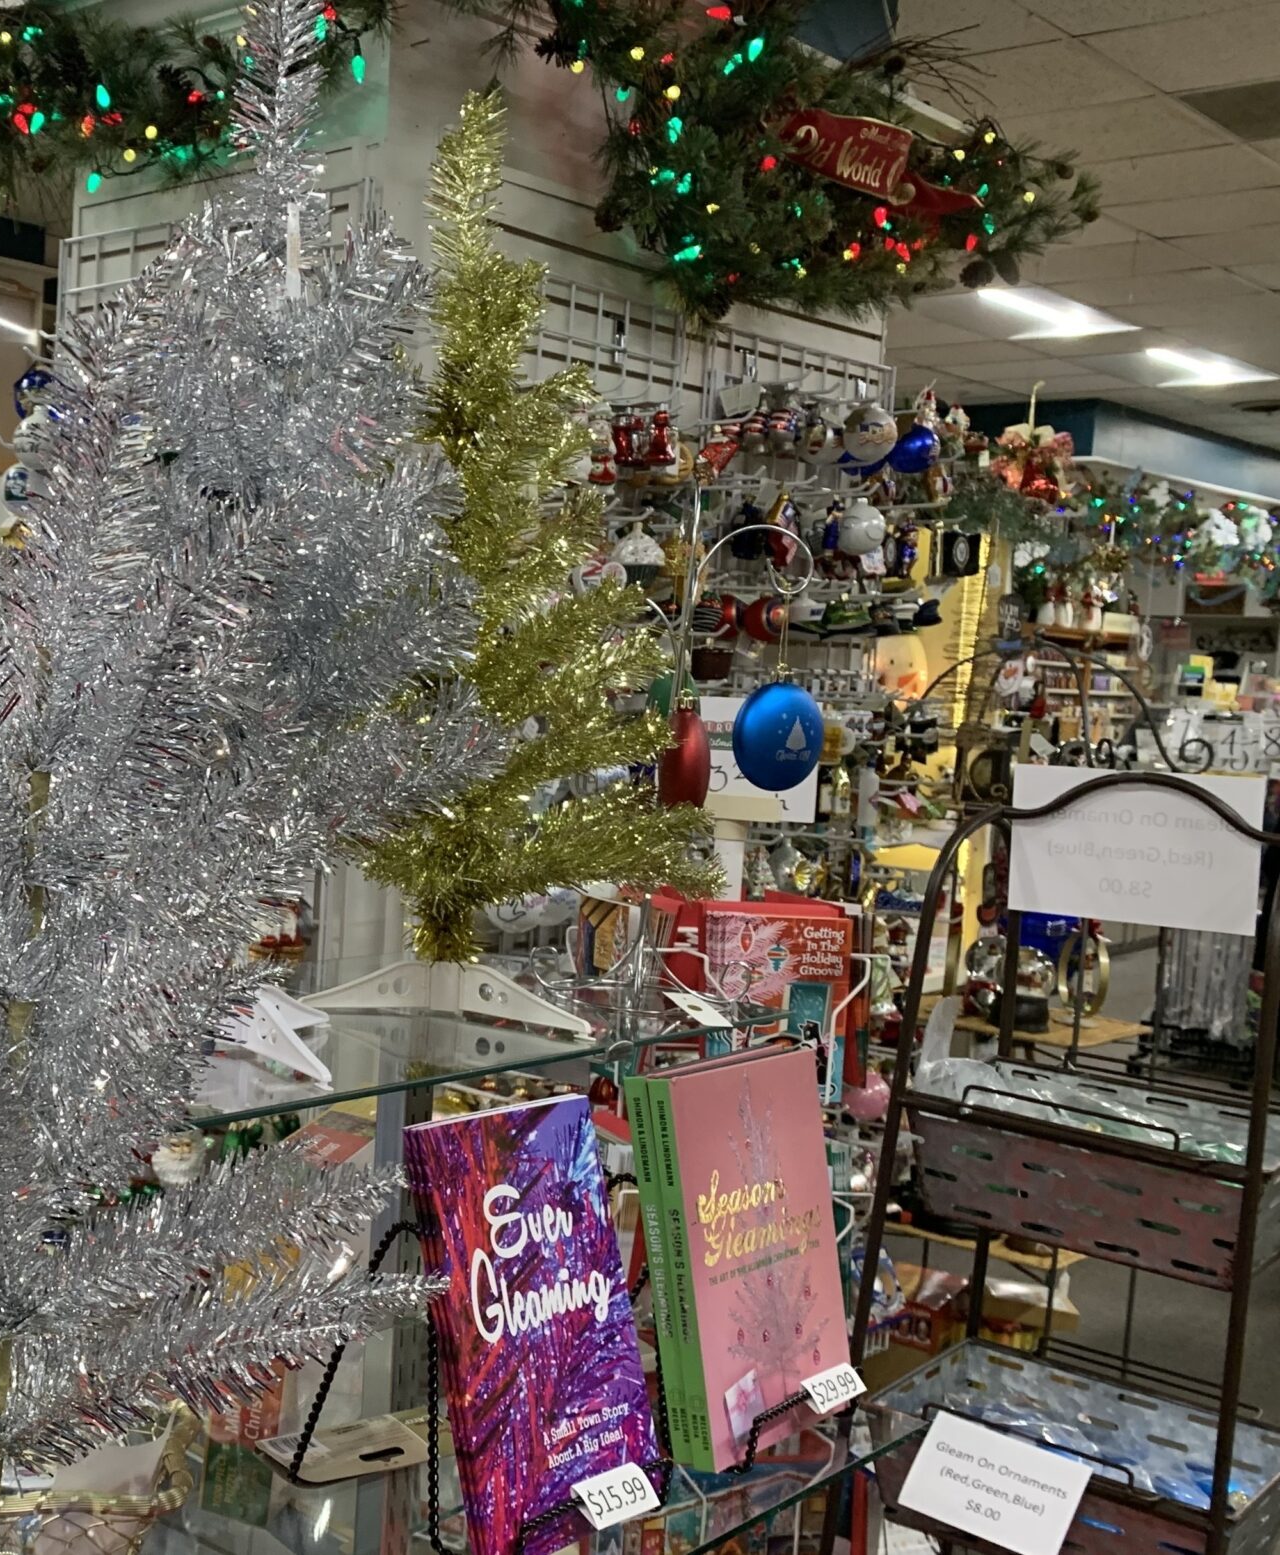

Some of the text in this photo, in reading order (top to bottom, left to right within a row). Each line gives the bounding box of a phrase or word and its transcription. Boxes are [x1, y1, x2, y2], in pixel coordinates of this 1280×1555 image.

[836, 136, 885, 187] World
[803, 926, 845, 945] Getting
[807, 941, 840, 952] In The
[799, 964, 844, 977] Groove!
[801, 953, 843, 968] Holiday
[633, 1097, 643, 1129] SHIMON
[639, 1138, 652, 1183] LINDEMANN
[657, 1100, 667, 1133] SHIMON
[663, 1141, 674, 1187] LINDEMANN
[483, 1183, 573, 1259] Ever
[645, 1205, 664, 1265] SEASON'S
[471, 1248, 610, 1343] Gleaming
[720, 1272, 729, 1283] ART
[812, 1371, 858, 1409] $29.99
[542, 1402, 629, 1446] A Small Town Story
[547, 1426, 624, 1469] About A Big Idea!
[936, 1441, 1068, 1500] Gleam On Ornaments
[939, 1465, 1045, 1517] (Red,Green,Blue)
[587, 1476, 647, 1520] $15.99
[965, 1499, 1001, 1522] $8.00
